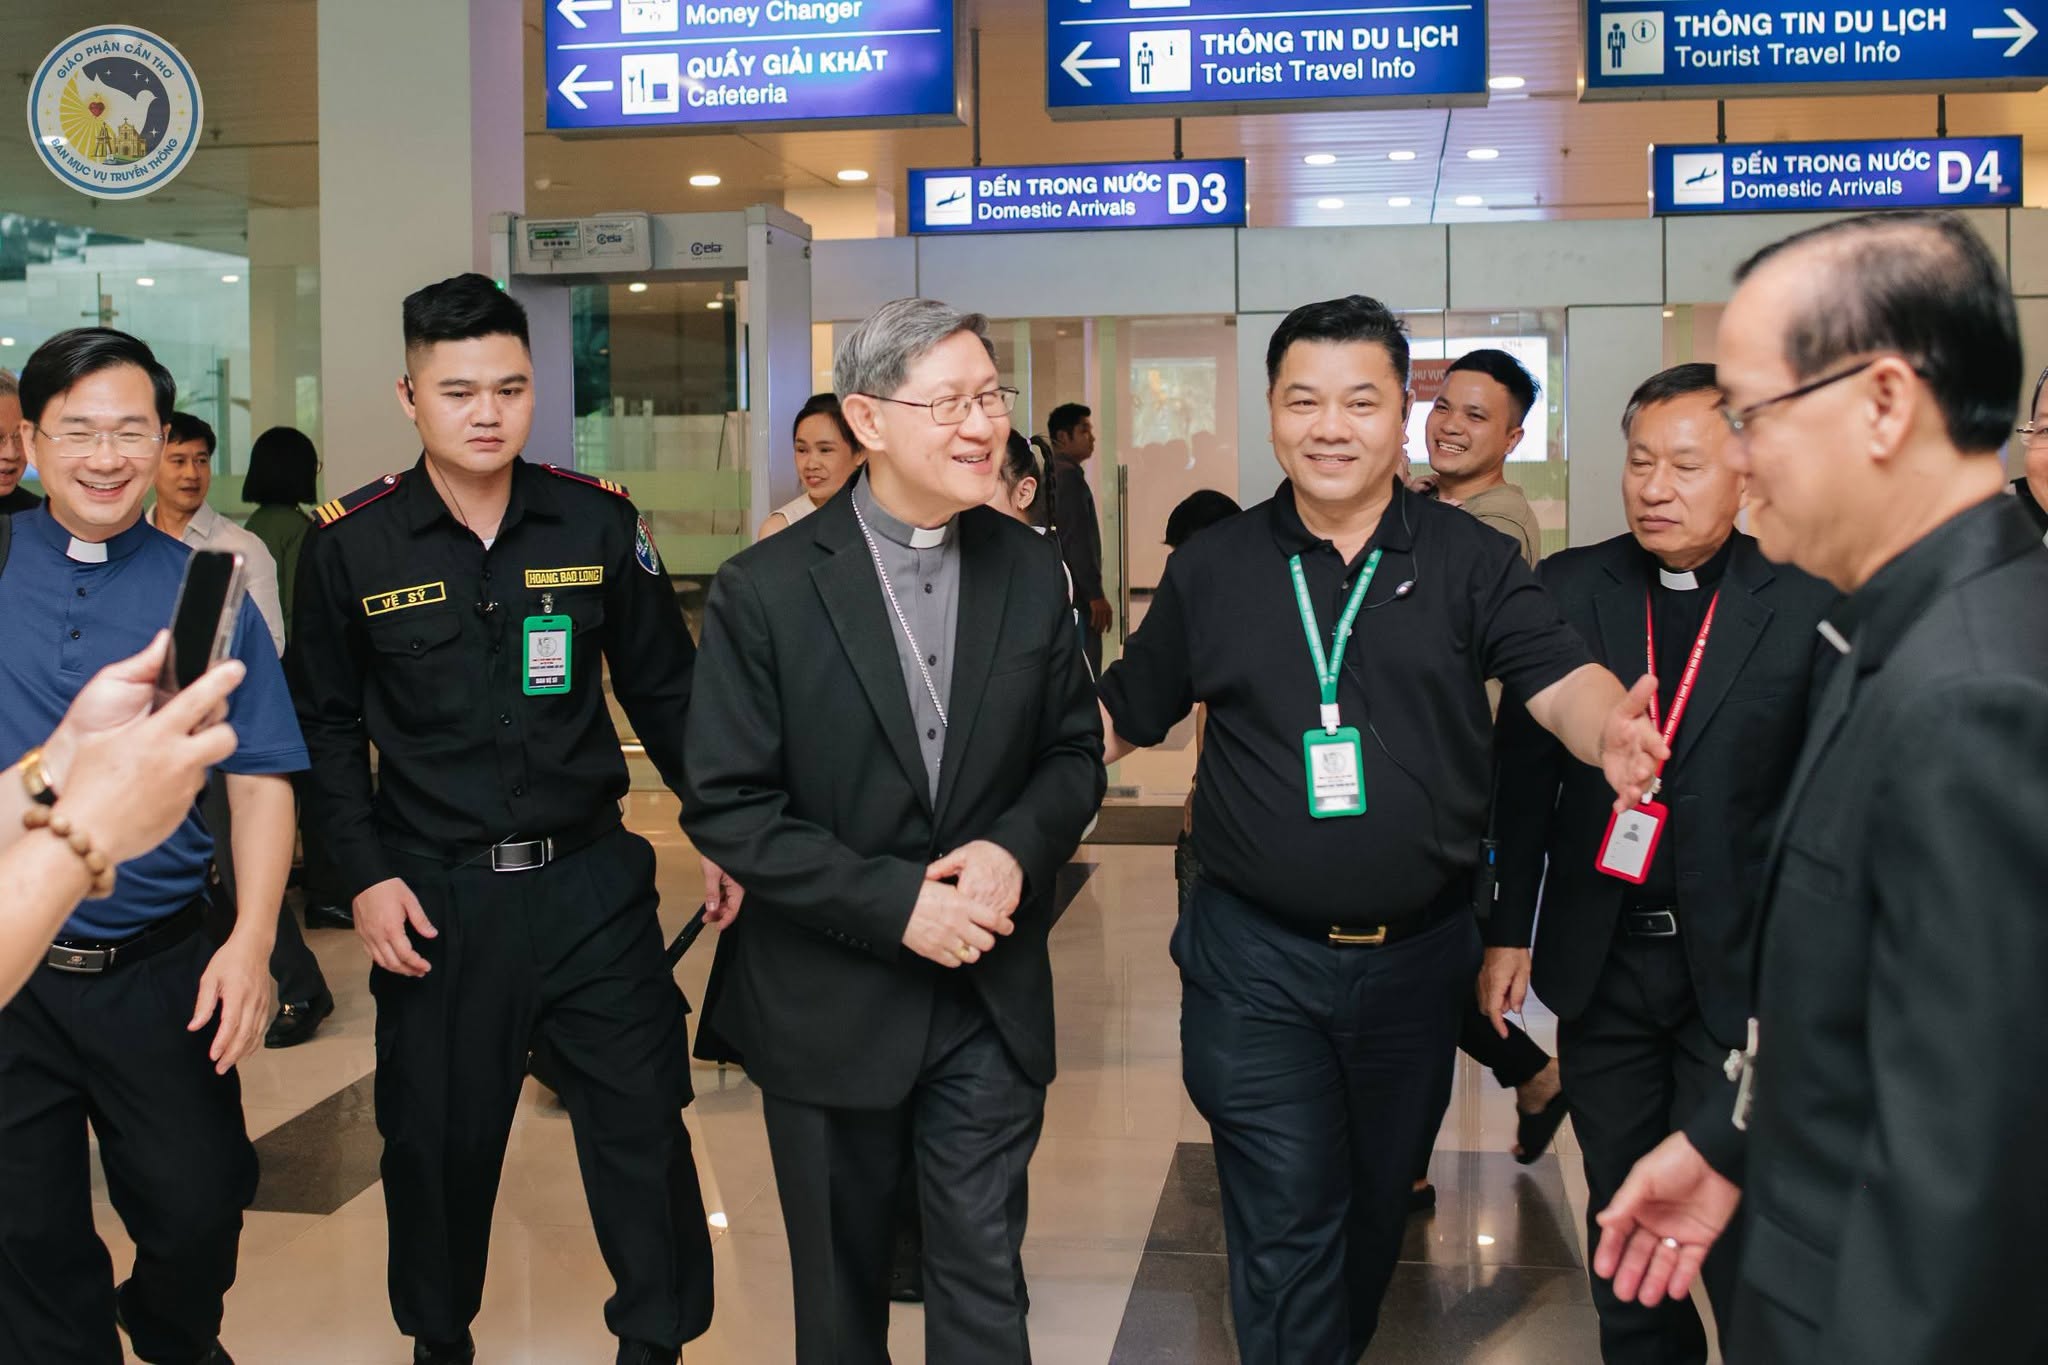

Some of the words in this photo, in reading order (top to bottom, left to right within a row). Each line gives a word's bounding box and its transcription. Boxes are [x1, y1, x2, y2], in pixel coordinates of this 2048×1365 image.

[686, 4, 760, 27] Money
[766, 0, 863, 24] Changer
[1674, 9, 1773, 37] THÔNG
[1780, 11, 1825, 35] TIN
[1834, 10, 1874, 34] DU
[1882, 8, 1946, 36] LỊCH
[1200, 27, 1294, 55] THÔNG
[1301, 29, 1344, 52] TIN
[1352, 27, 1390, 50] DU
[1397, 25, 1459, 52] LỊCH
[762, 46, 813, 75] GIẢI
[820, 45, 888, 73] KHÁT
[1674, 44, 1760, 68] Tourist
[1767, 41, 1845, 65] Travel
[1854, 40, 1901, 63] Info
[1200, 61, 1282, 85] Tourist
[1288, 58, 1363, 81] Travel
[1371, 56, 1416, 79] Info
[687, 83, 788, 107] Cafeteria
[1731, 150, 1777, 175] ĐẾN
[1784, 153, 1861, 173] TRONG
[1868, 148, 1931, 171] NƯỚC
[1938, 150, 2002, 194] D4
[979, 173, 1021, 197] ĐẾN
[1026, 176, 1098, 196] TRONG
[1103, 170, 1162, 193] NƯỚC
[1168, 173, 1227, 214] D3
[1731, 178, 1822, 199] Domestic
[1828, 176, 1903, 196] Arrivals
[978, 201, 1062, 220] Domestic
[1067, 199, 1136, 217] Arrivals
[529, 572, 559, 584] HOANG
[560, 571, 577, 583] BAO
[578, 570, 599, 582] LONG
